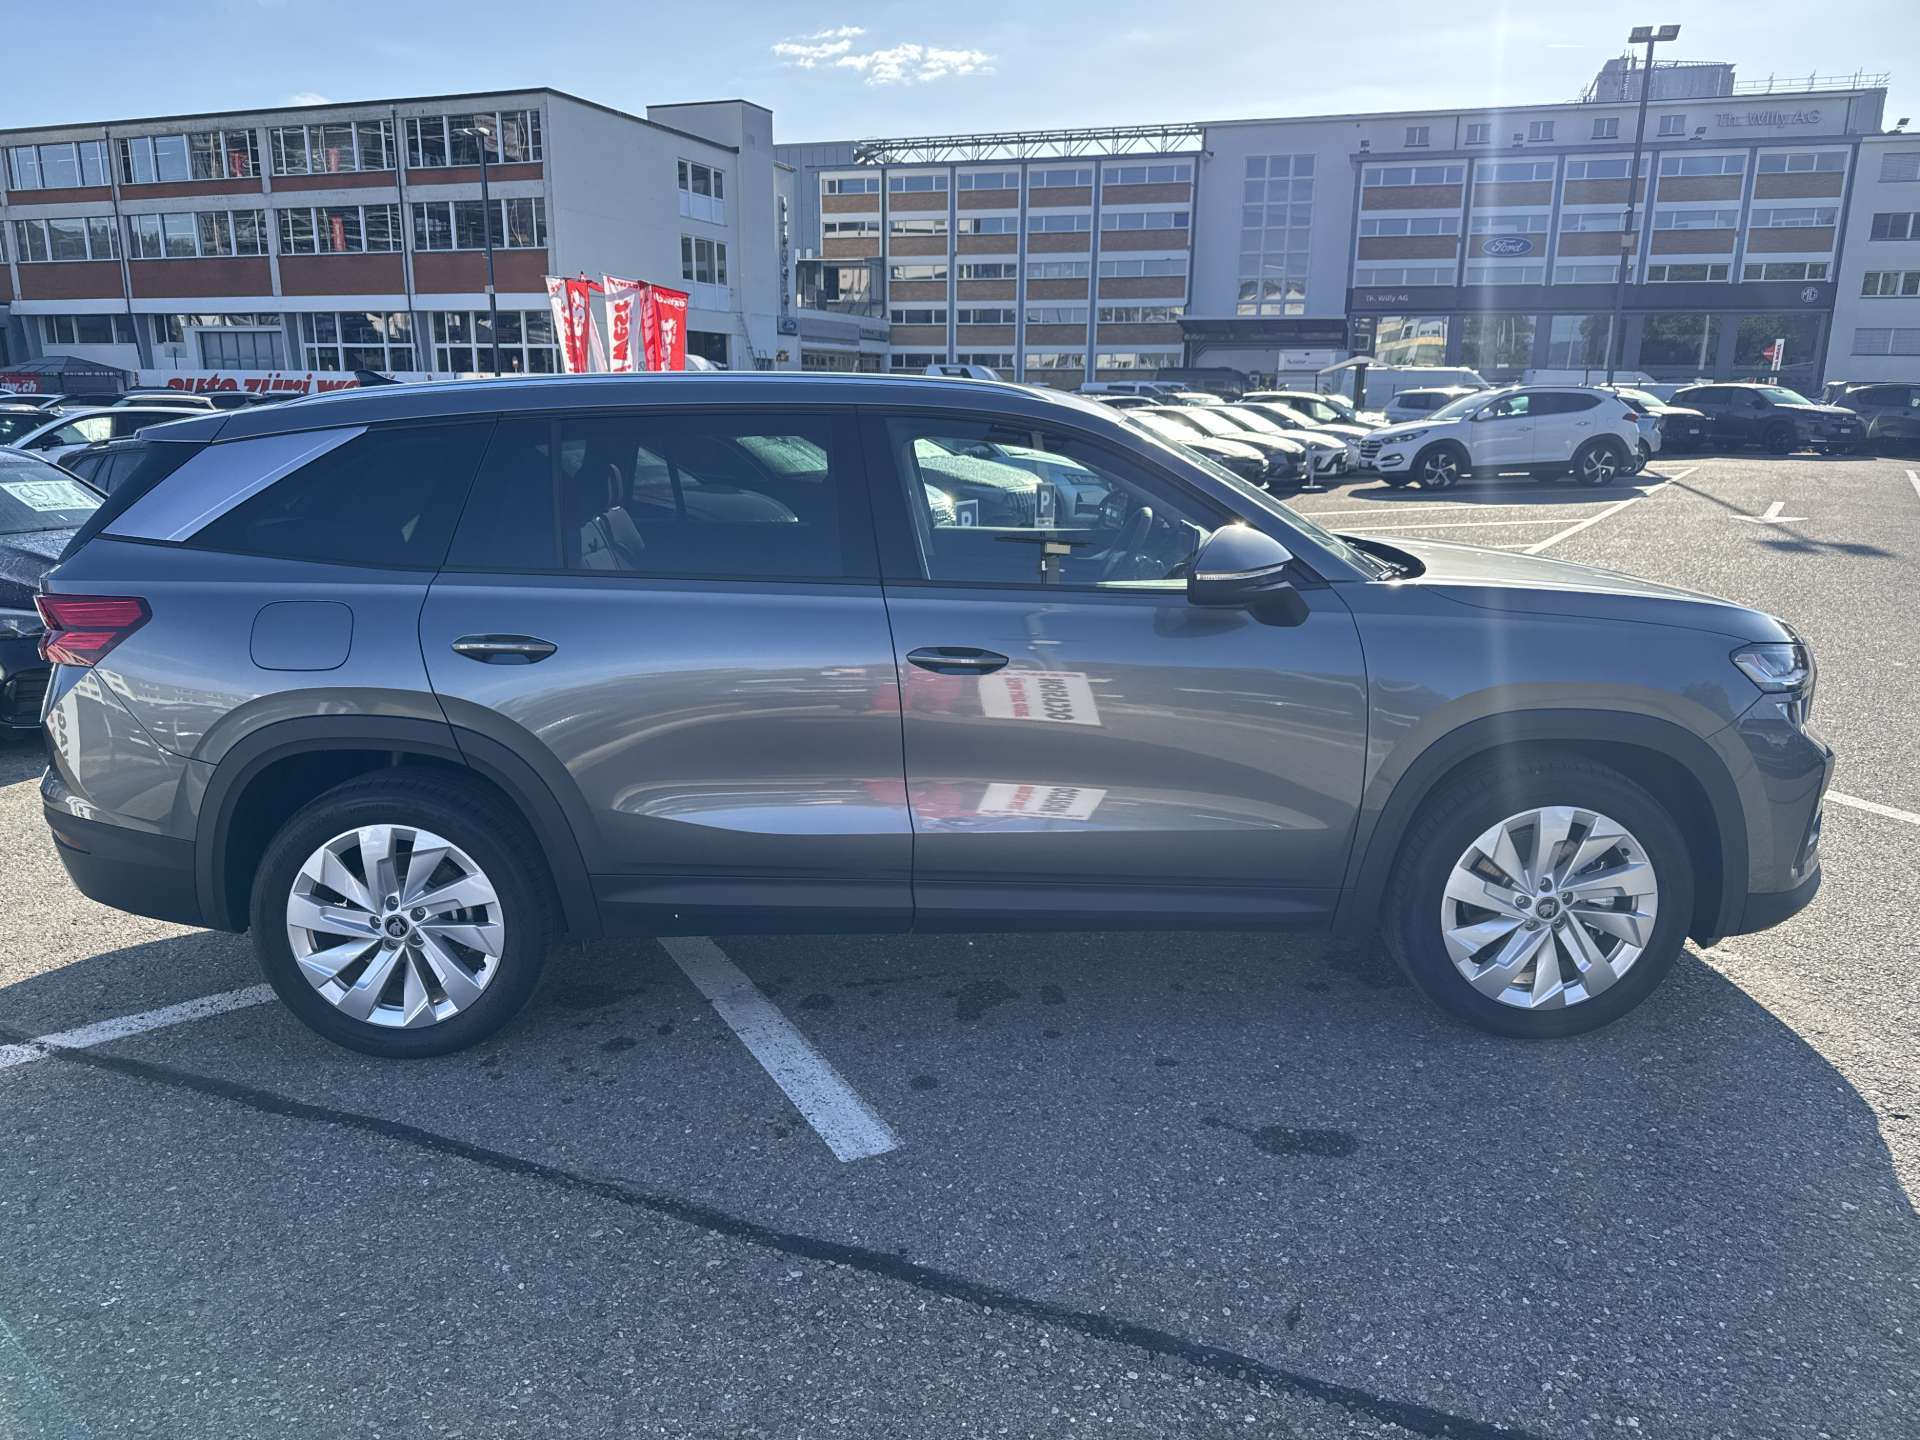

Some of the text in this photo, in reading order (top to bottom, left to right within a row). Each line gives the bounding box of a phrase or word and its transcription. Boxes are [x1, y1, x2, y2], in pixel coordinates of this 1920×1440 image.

[1746, 110, 1786, 128] Willy
[1791, 109, 1821, 124] AG
[1378, 294, 1396, 303] Willy
[167, 372, 360, 394] auto züri we
[1040, 491, 1050, 513] P
